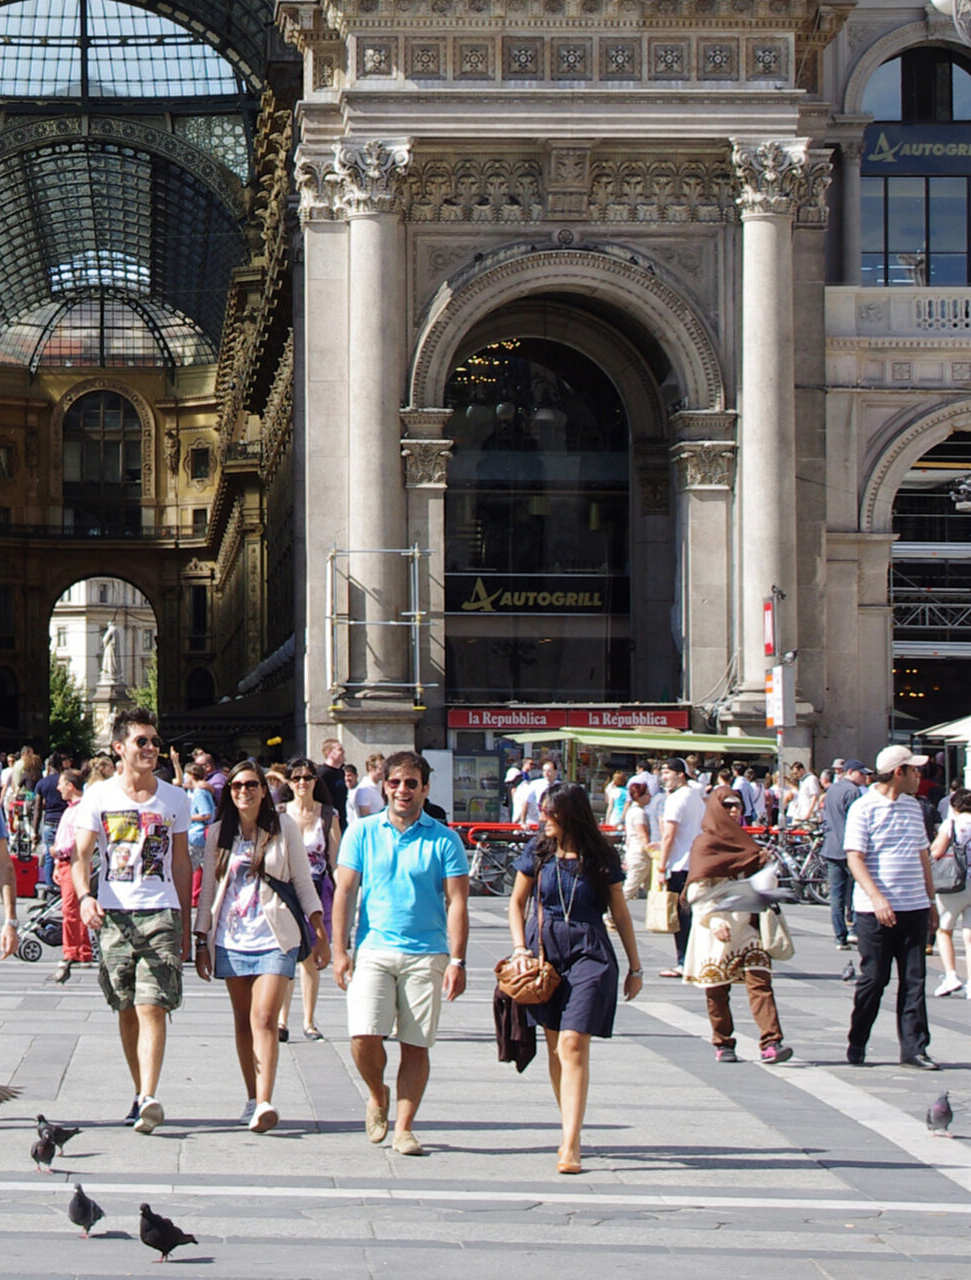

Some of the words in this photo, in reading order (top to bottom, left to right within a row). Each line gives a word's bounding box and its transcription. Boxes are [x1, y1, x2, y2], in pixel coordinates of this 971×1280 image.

[499, 591, 602, 607] AUTOGRILL
[468, 711, 480, 724] la
[482, 711, 547, 726] Repubblica
[588, 711, 600, 724] la
[602, 711, 668, 727] Repubblica
